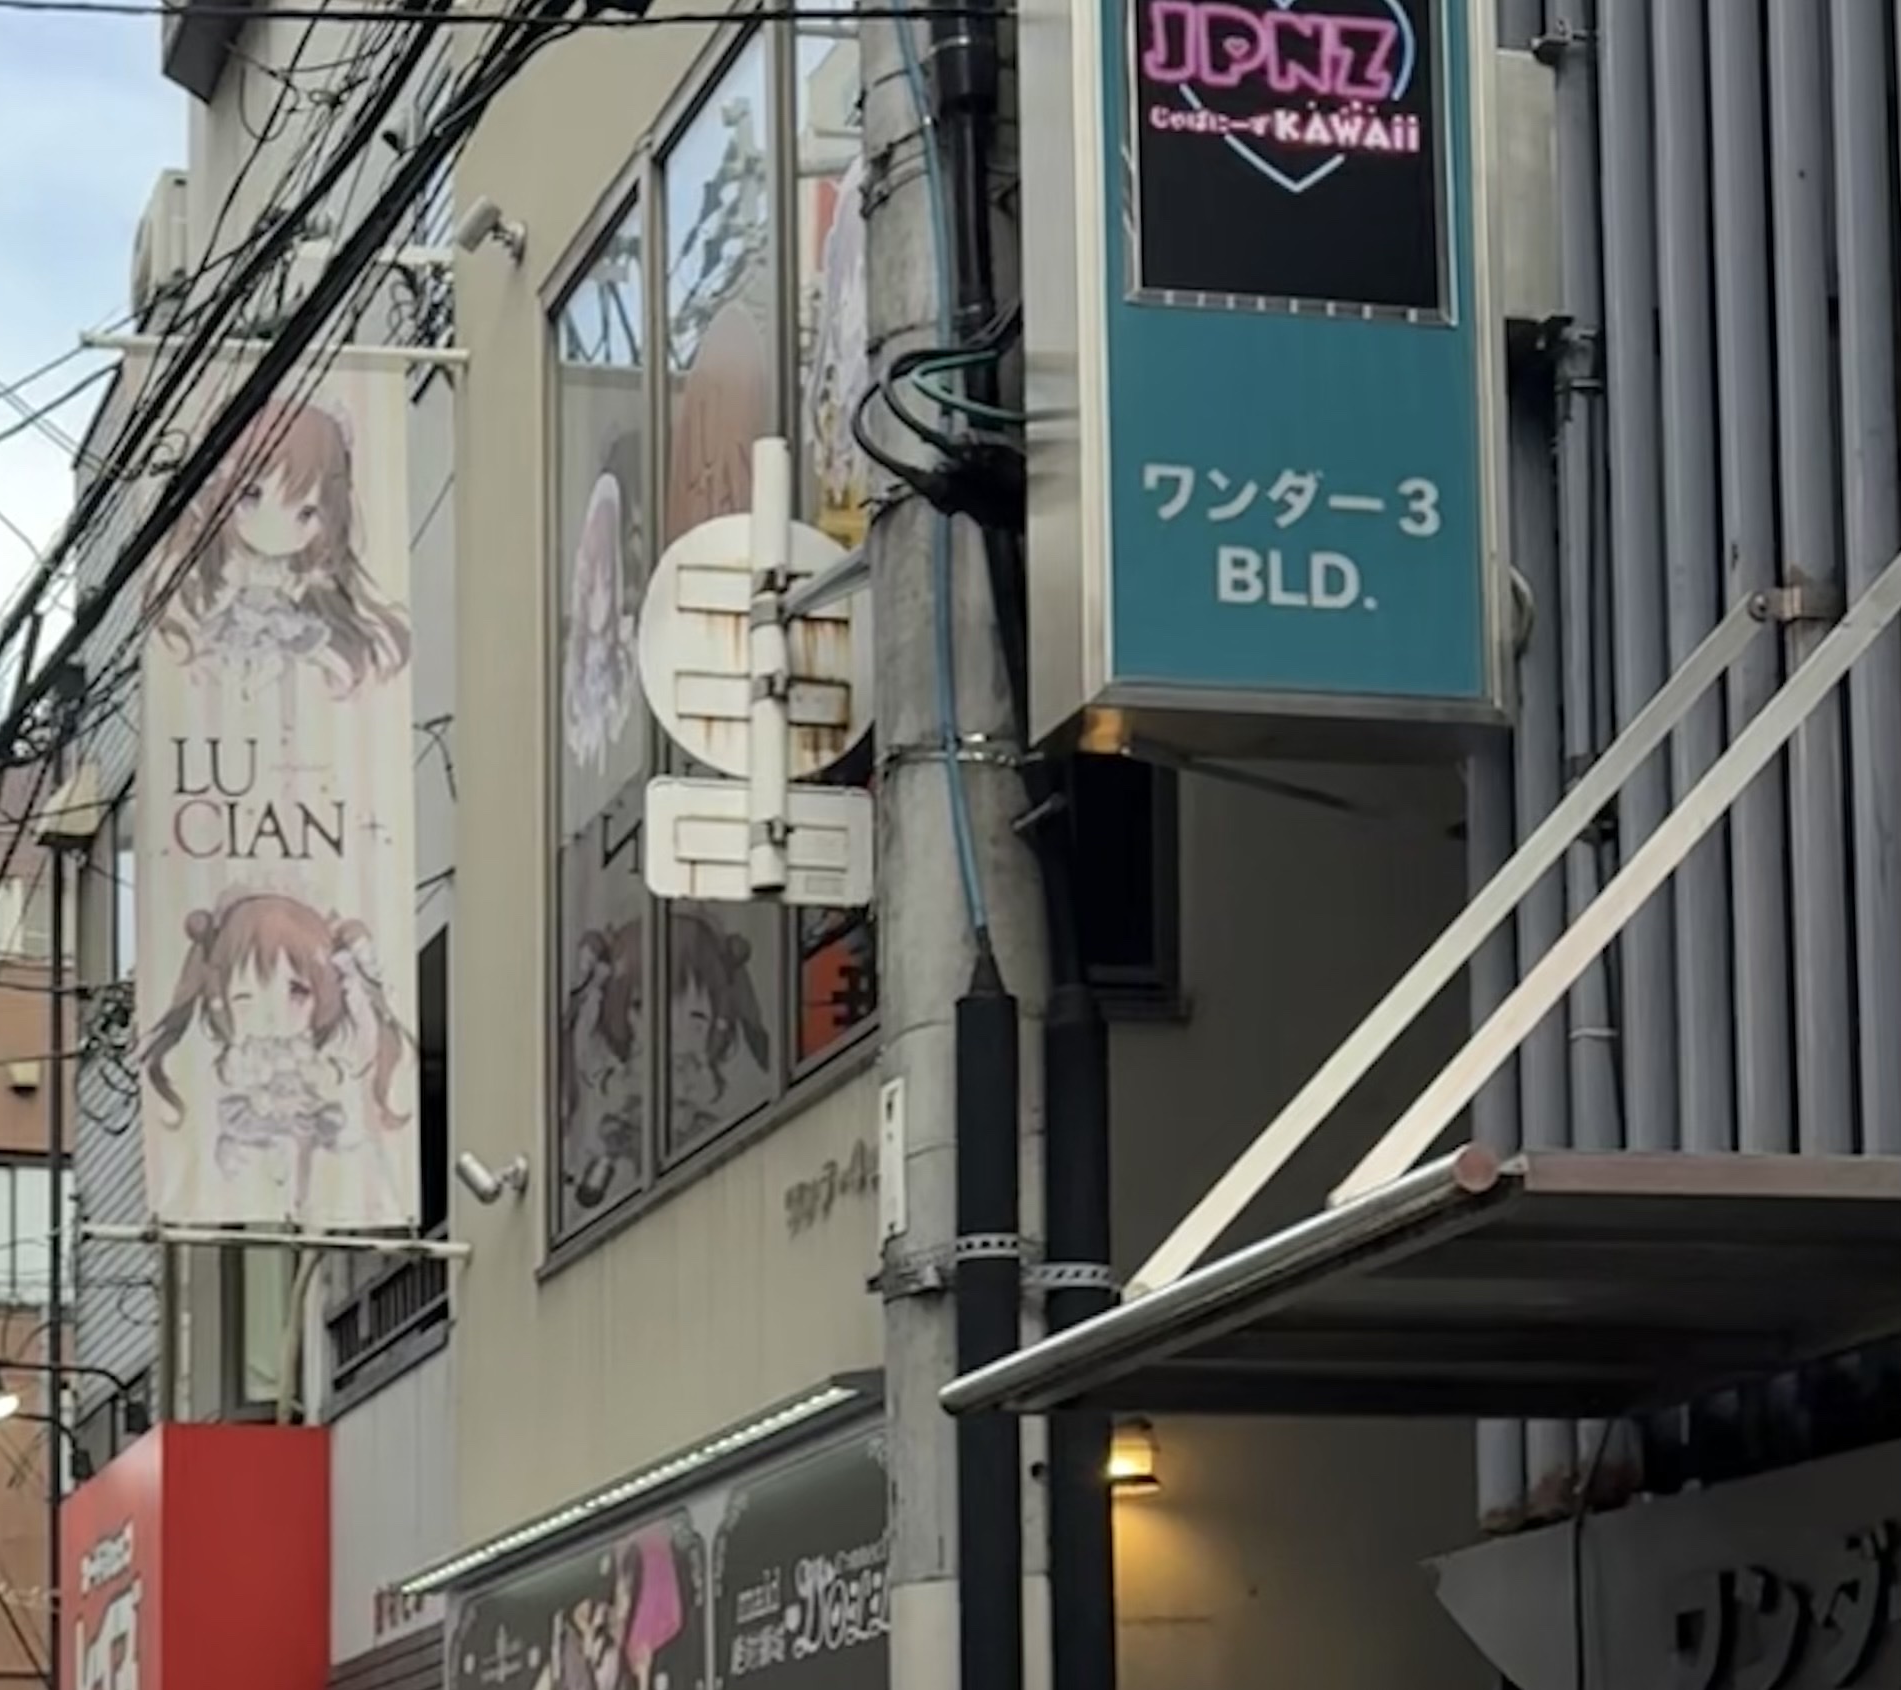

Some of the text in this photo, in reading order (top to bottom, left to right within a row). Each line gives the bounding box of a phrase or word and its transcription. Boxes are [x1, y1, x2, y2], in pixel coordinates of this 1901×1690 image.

[1144, 1, 1400, 100] JPNZ
[1143, 463, 1441, 537] ワンダー3
[1216, 545, 1378, 610] BLD.
[170, 736, 258, 797] LU
[172, 799, 346, 860] CIAN
